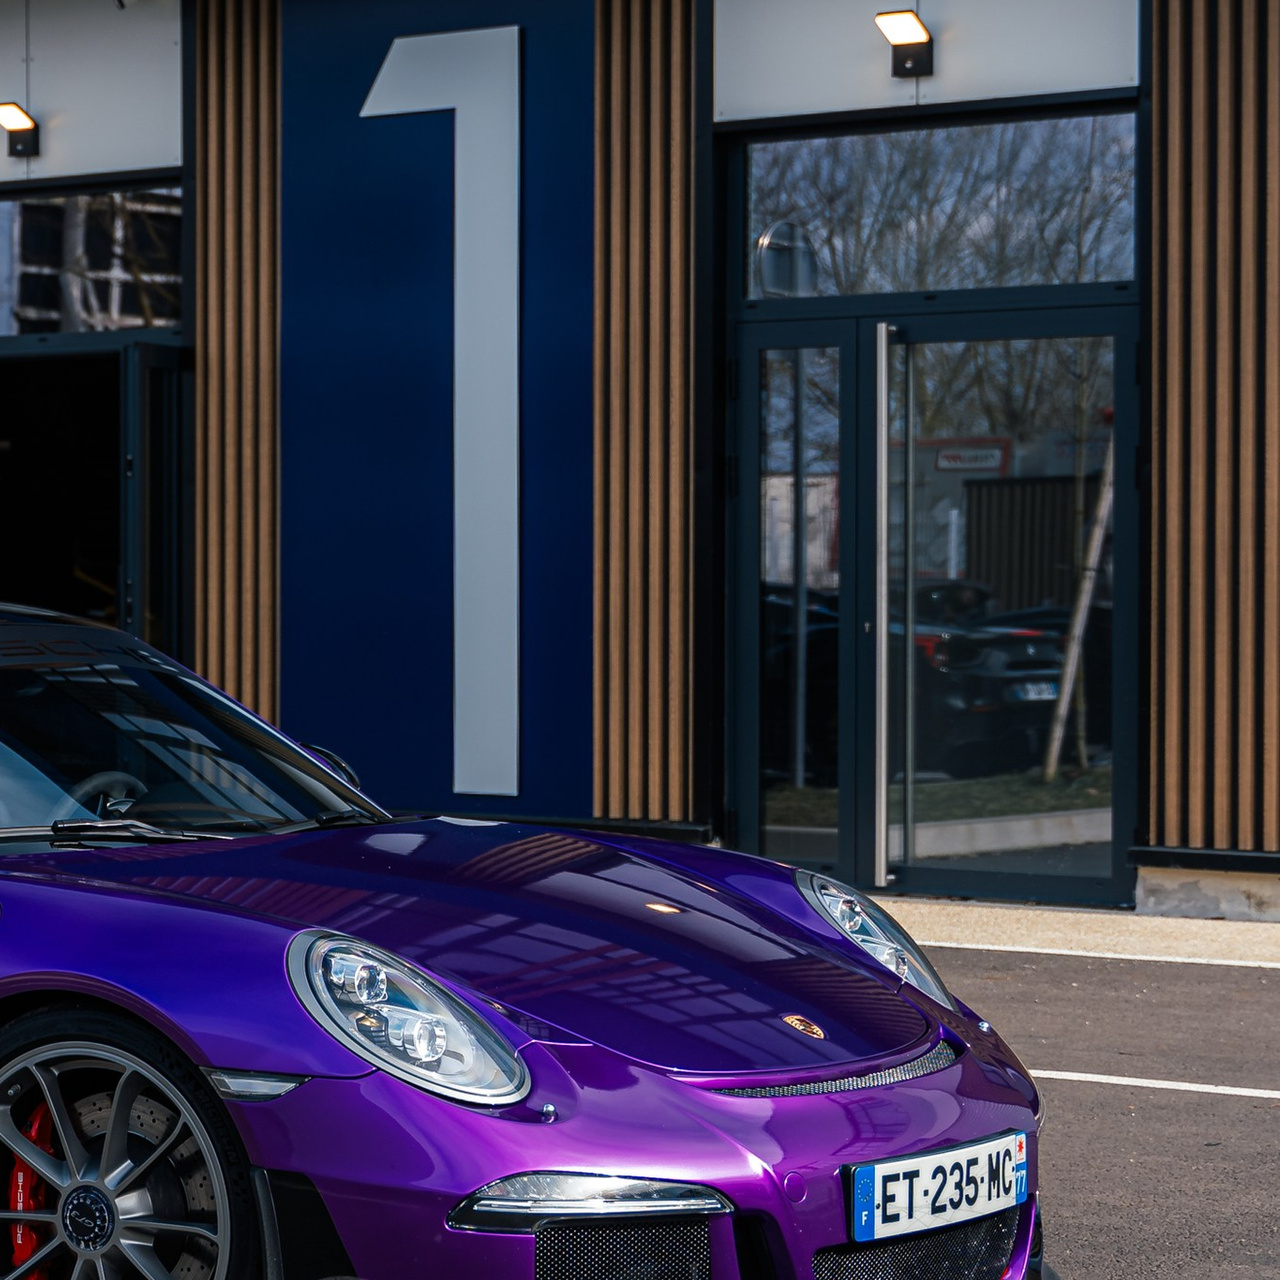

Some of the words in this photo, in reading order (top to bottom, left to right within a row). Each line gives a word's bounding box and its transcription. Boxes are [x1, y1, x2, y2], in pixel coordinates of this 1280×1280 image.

[359, 24, 520, 797] 1
[1016, 1169, 1026, 1195] 77
[16, 1172, 24, 1244] POSCHE
[861, 1211, 869, 1226] F
